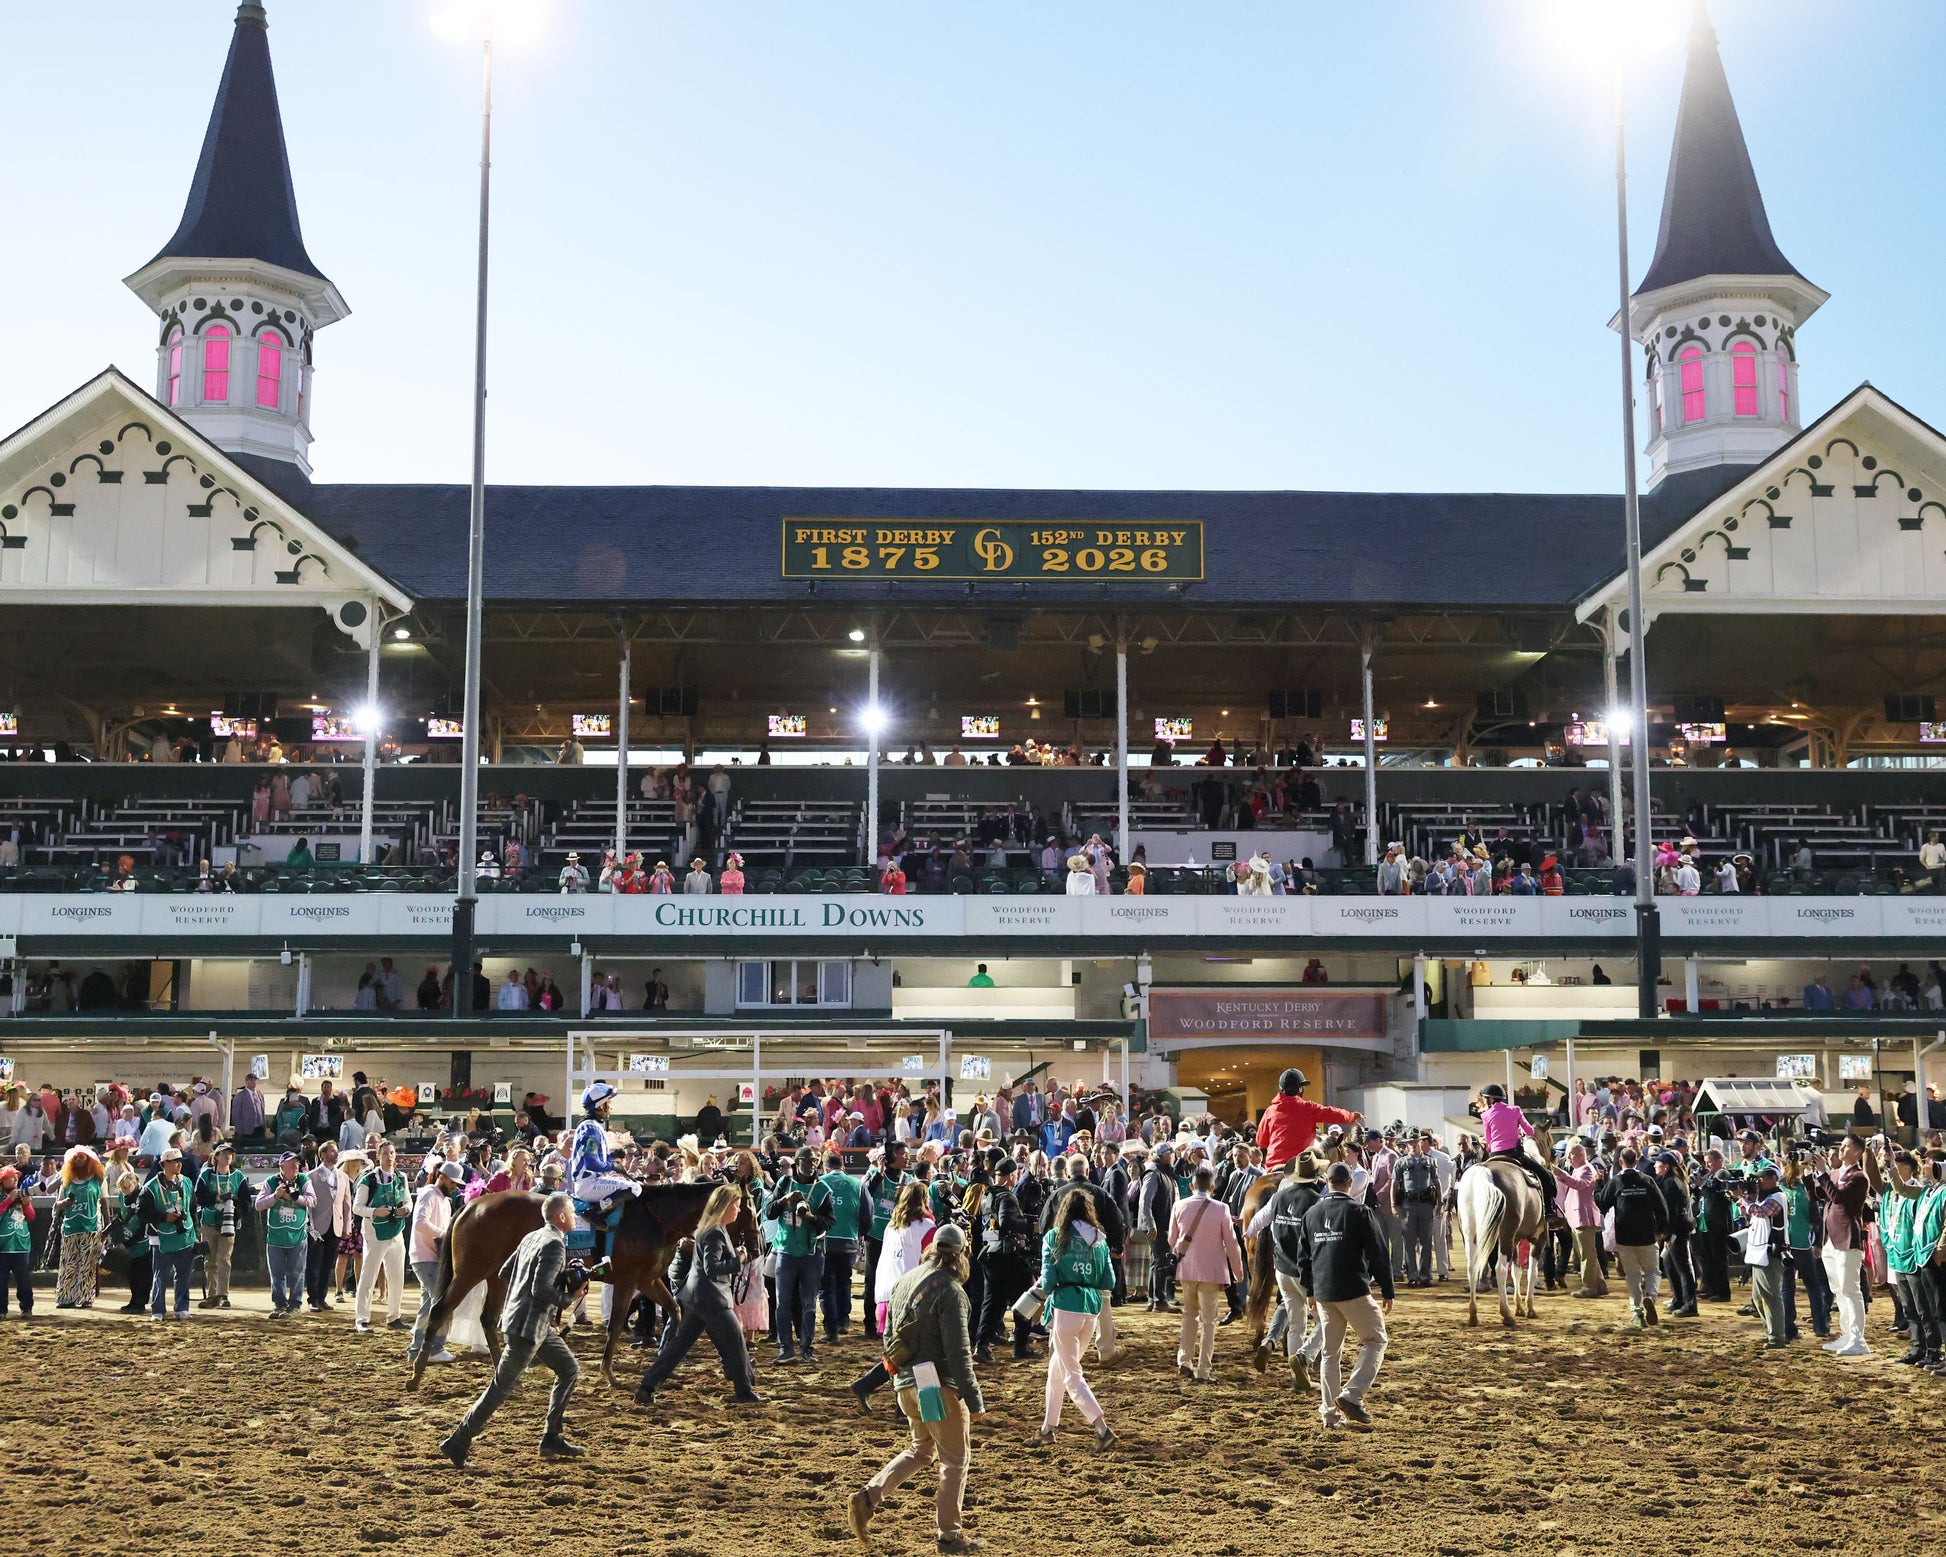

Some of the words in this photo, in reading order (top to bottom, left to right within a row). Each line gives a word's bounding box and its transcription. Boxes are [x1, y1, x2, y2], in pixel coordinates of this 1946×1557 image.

[795, 529, 867, 545] FIRST
[875, 529, 956, 545] DERBY
[1030, 530, 1085, 546] 152ND
[1096, 530, 1187, 547] DERBY
[811, 546, 941, 570] 1875
[1042, 548, 1169, 573] 2026
[51, 907, 112, 917] LONGINES
[169, 905, 235, 914] WOODFORD
[290, 907, 350, 917] LONGINES
[526, 907, 585, 917] LONGINES
[655, 902, 806, 927] CHURCHILL
[822, 902, 925, 927] DOWNS
[992, 906, 1056, 914] WOODFORD
[1110, 907, 1169, 918] LONGINES
[1223, 906, 1287, 914] WOODFORD
[1340, 908, 1399, 918] LONGINES
[1453, 907, 1517, 915] WOODFORD
[1569, 908, 1627, 918] LONGINES
[1680, 907, 1744, 915] WOODFORD
[1797, 908, 1855, 918] LONGINES
[175, 916, 229, 924] RESERVE
[412, 916, 454, 924] RESER
[999, 916, 1051, 925] RESERVE
[1230, 917, 1281, 925] RESERVE
[1460, 917, 1512, 925] RESERVE
[1687, 917, 1740, 926] RESERVE
[1216, 1002, 1279, 1013] KENTUCKY
[1284, 1002, 1321, 1013] DERBY
[1180, 1018, 1273, 1029] WOODFORD
[1280, 1018, 1356, 1029] RESERVE
[71, 1203, 89, 1212] 227
[279, 1214, 297, 1223] 360
[1072, 1261, 1093, 1275] 439
